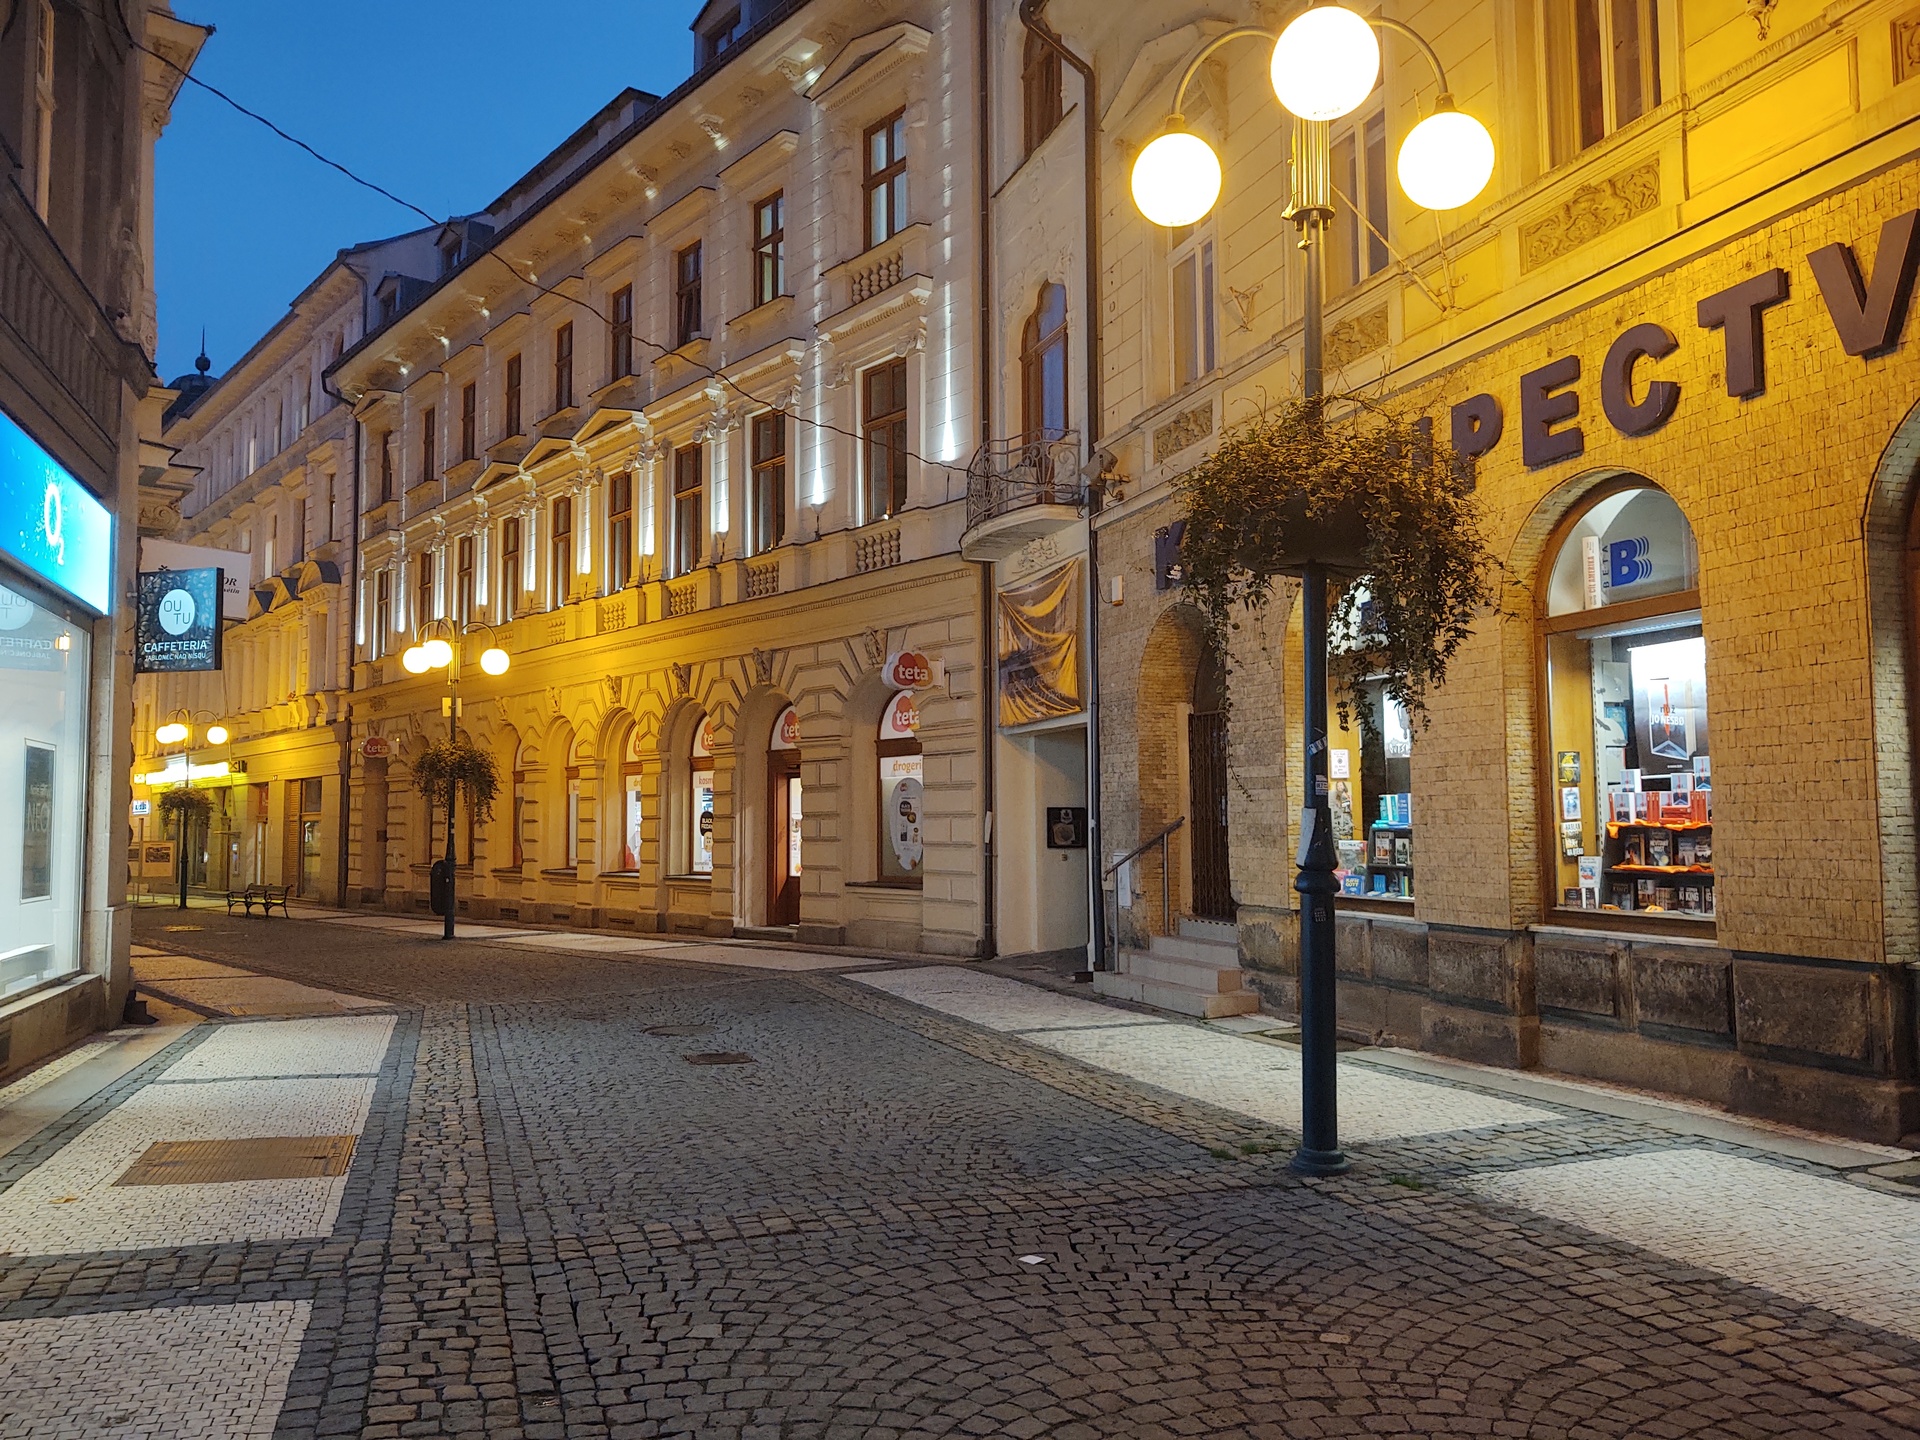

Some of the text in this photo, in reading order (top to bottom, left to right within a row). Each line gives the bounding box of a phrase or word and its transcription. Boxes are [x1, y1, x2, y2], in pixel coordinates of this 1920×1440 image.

[1602, 545, 1610, 588] BETA
[164, 600, 182, 613] OU
[174, 612, 191, 625] TU
[144, 639, 208, 653] CAFFETERIA
[899, 664, 928, 681] teta
[367, 744, 387, 753] teta
[1685, 891, 1700, 902] KING
